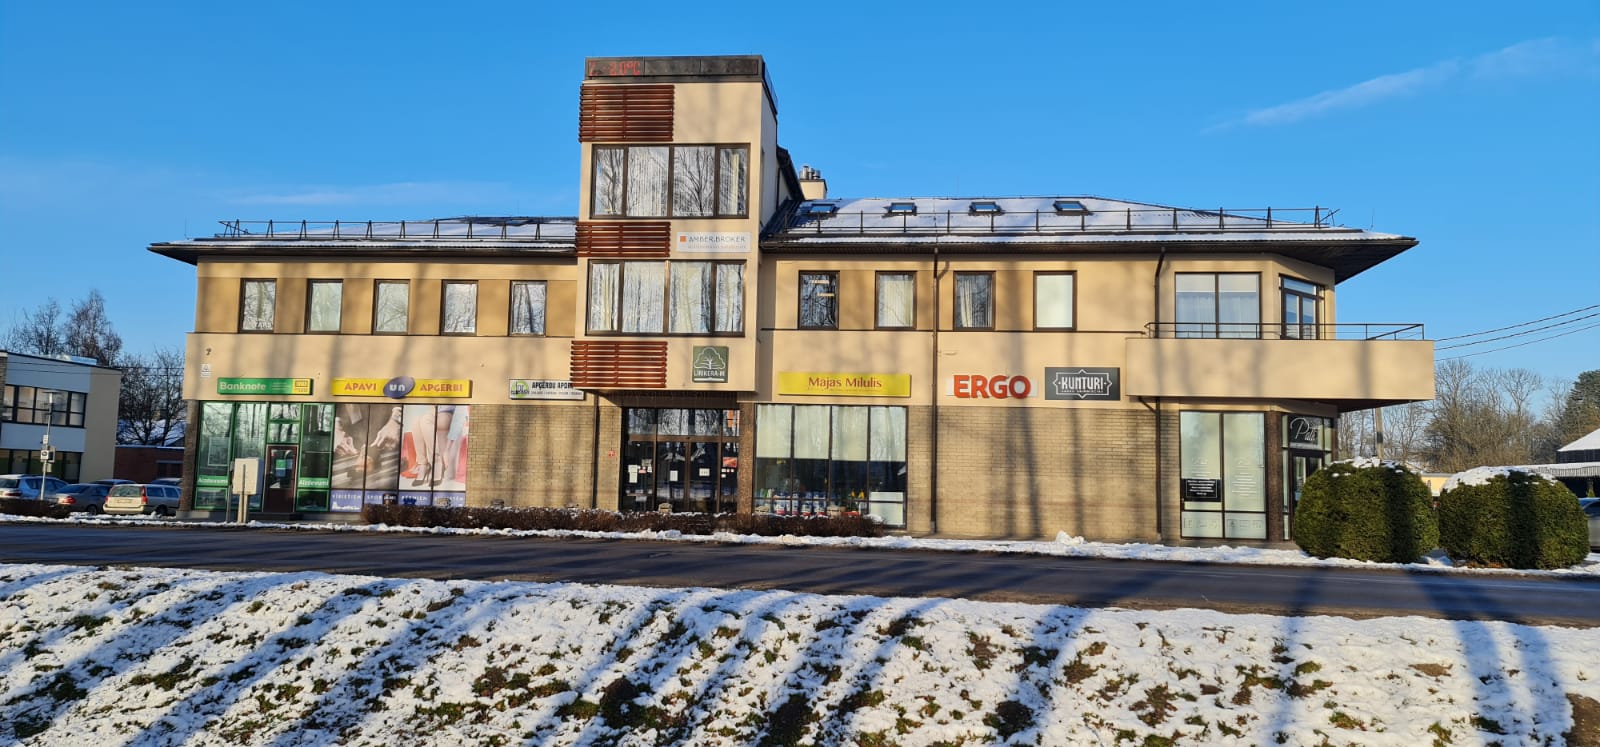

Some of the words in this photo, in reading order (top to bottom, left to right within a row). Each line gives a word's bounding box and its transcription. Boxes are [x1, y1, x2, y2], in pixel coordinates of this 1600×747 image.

[219, 381, 266, 391] Banknote
[344, 382, 377, 391] APAVI
[389, 384, 405, 392] un
[845, 377, 882, 388] Milulis
[954, 375, 1032, 399] ERGO
[1061, 377, 1104, 390] KUNTURI
